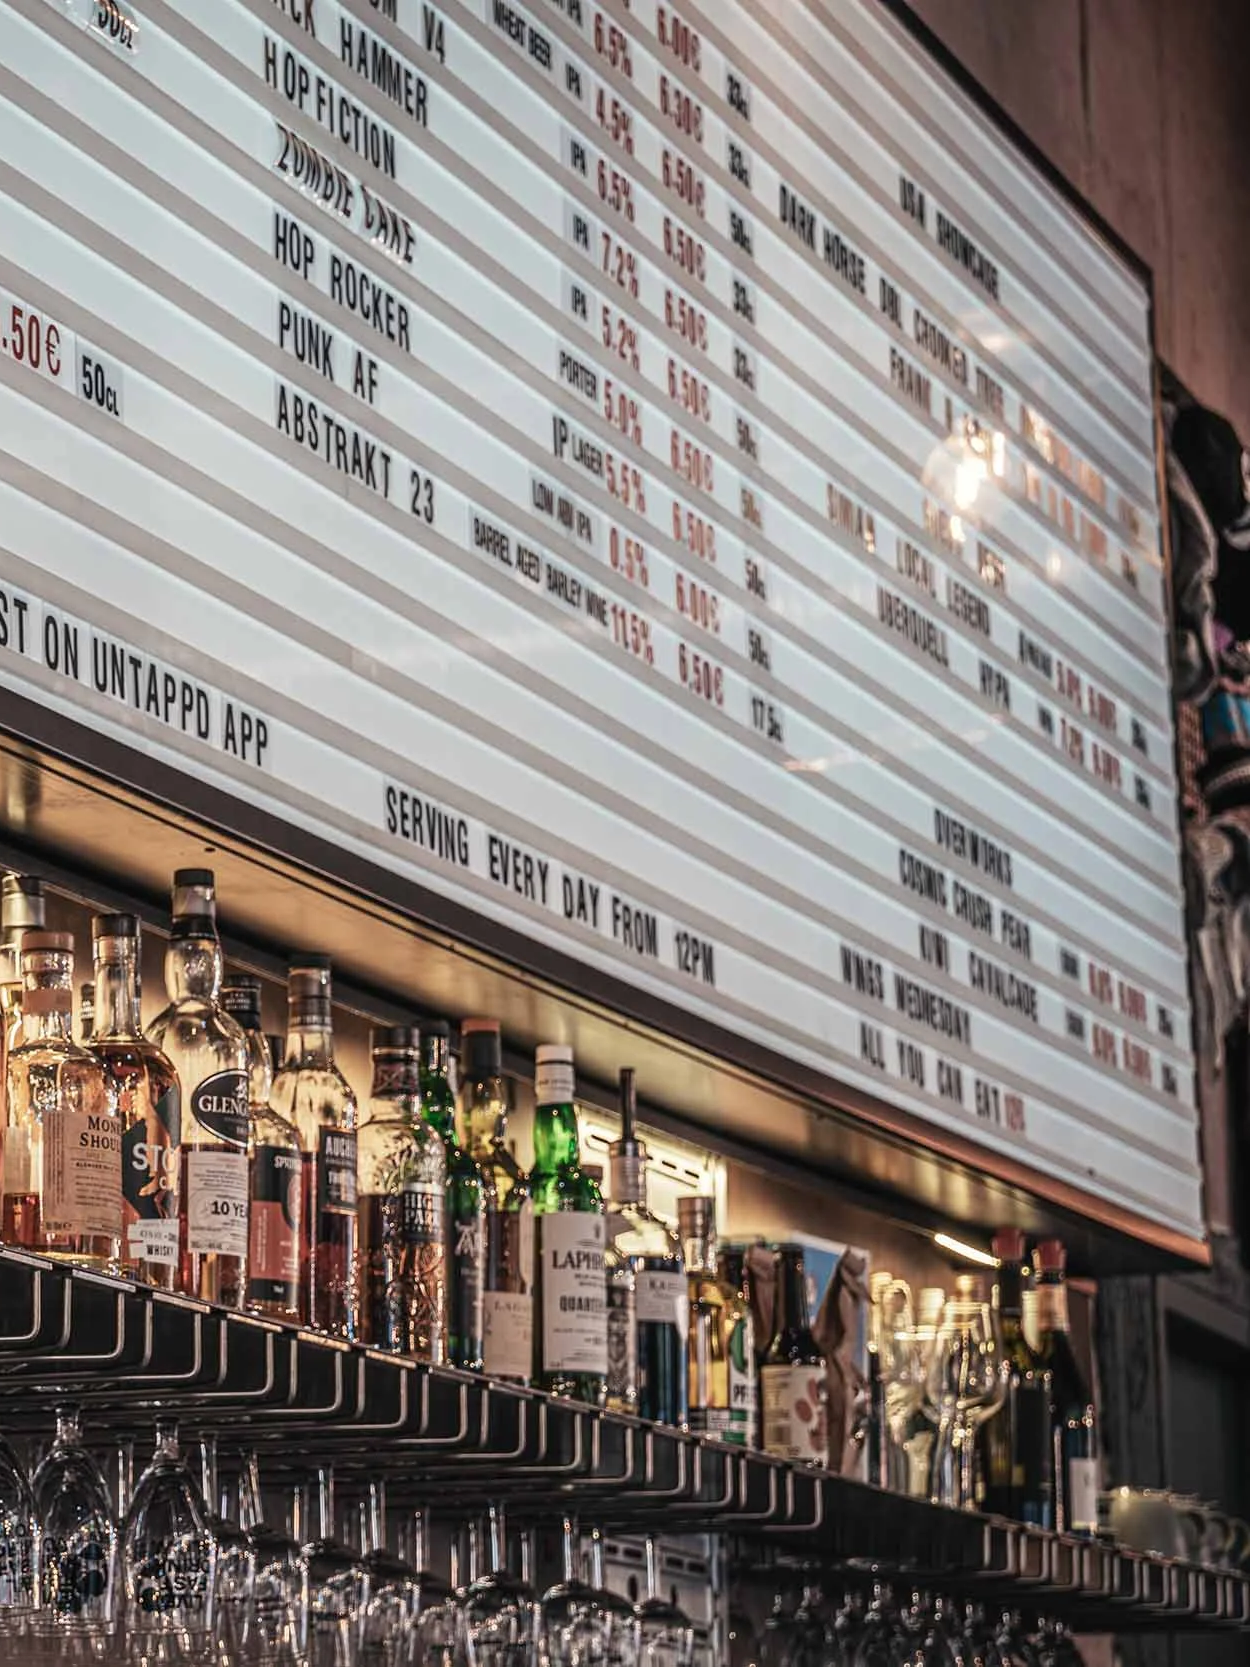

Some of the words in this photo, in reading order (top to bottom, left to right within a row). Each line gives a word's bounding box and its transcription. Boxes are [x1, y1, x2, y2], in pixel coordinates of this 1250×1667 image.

[594, 12, 633, 78] 6.5%
[659, 75, 703, 143] 6.30€
[657, 7, 701, 73] 6.00€
[340, 17, 429, 128] HAMMER
[573, 214, 589, 251] IPA
[601, 231, 639, 299] 7.2%
[665, 289, 708, 351] 6.50€
[422, 4, 446, 64] V4
[570, 139, 587, 177] IPA
[597, 158, 635, 223] 6.5%
[663, 216, 706, 281] 6.50€
[565, 64, 582, 100] IPA
[662, 149, 706, 220] 6.50€
[779, 183, 817, 251] DARK
[822, 225, 866, 295] HORSE
[274, 212, 315, 281] HOP
[330, 253, 411, 352] ROCKER
[552, 415, 568, 457] IP
[572, 433, 604, 478] LAGER
[605, 453, 646, 513] 5.5%
[360, 184, 415, 264] CAKE
[560, 350, 598, 400] PORTER
[603, 380, 643, 446] 5.0%
[670, 430, 714, 491] 6.50€
[571, 285, 588, 322] IPA
[602, 305, 640, 372] 5.2%
[668, 358, 711, 422] 6.50€
[277, 385, 392, 499] ABSTRAKT
[410, 470, 435, 524] 23
[473, 517, 513, 568] BARREL
[279, 301, 334, 382] PUNK
[353, 351, 379, 405] AF
[577, 510, 593, 544] IPA
[609, 527, 648, 587] 0.5%
[44, 615, 79, 680] ON
[93, 637, 210, 739] UNTAPPD
[223, 703, 269, 776] APP
[386, 785, 469, 866] SERVING
[488, 833, 550, 905] EVERY
[561, 873, 600, 927] DAY
[611, 896, 659, 958] FROM
[673, 929, 716, 985] 12PM
[897, 1038, 926, 1089] YOU
[211, 1200, 230, 1215] 10
